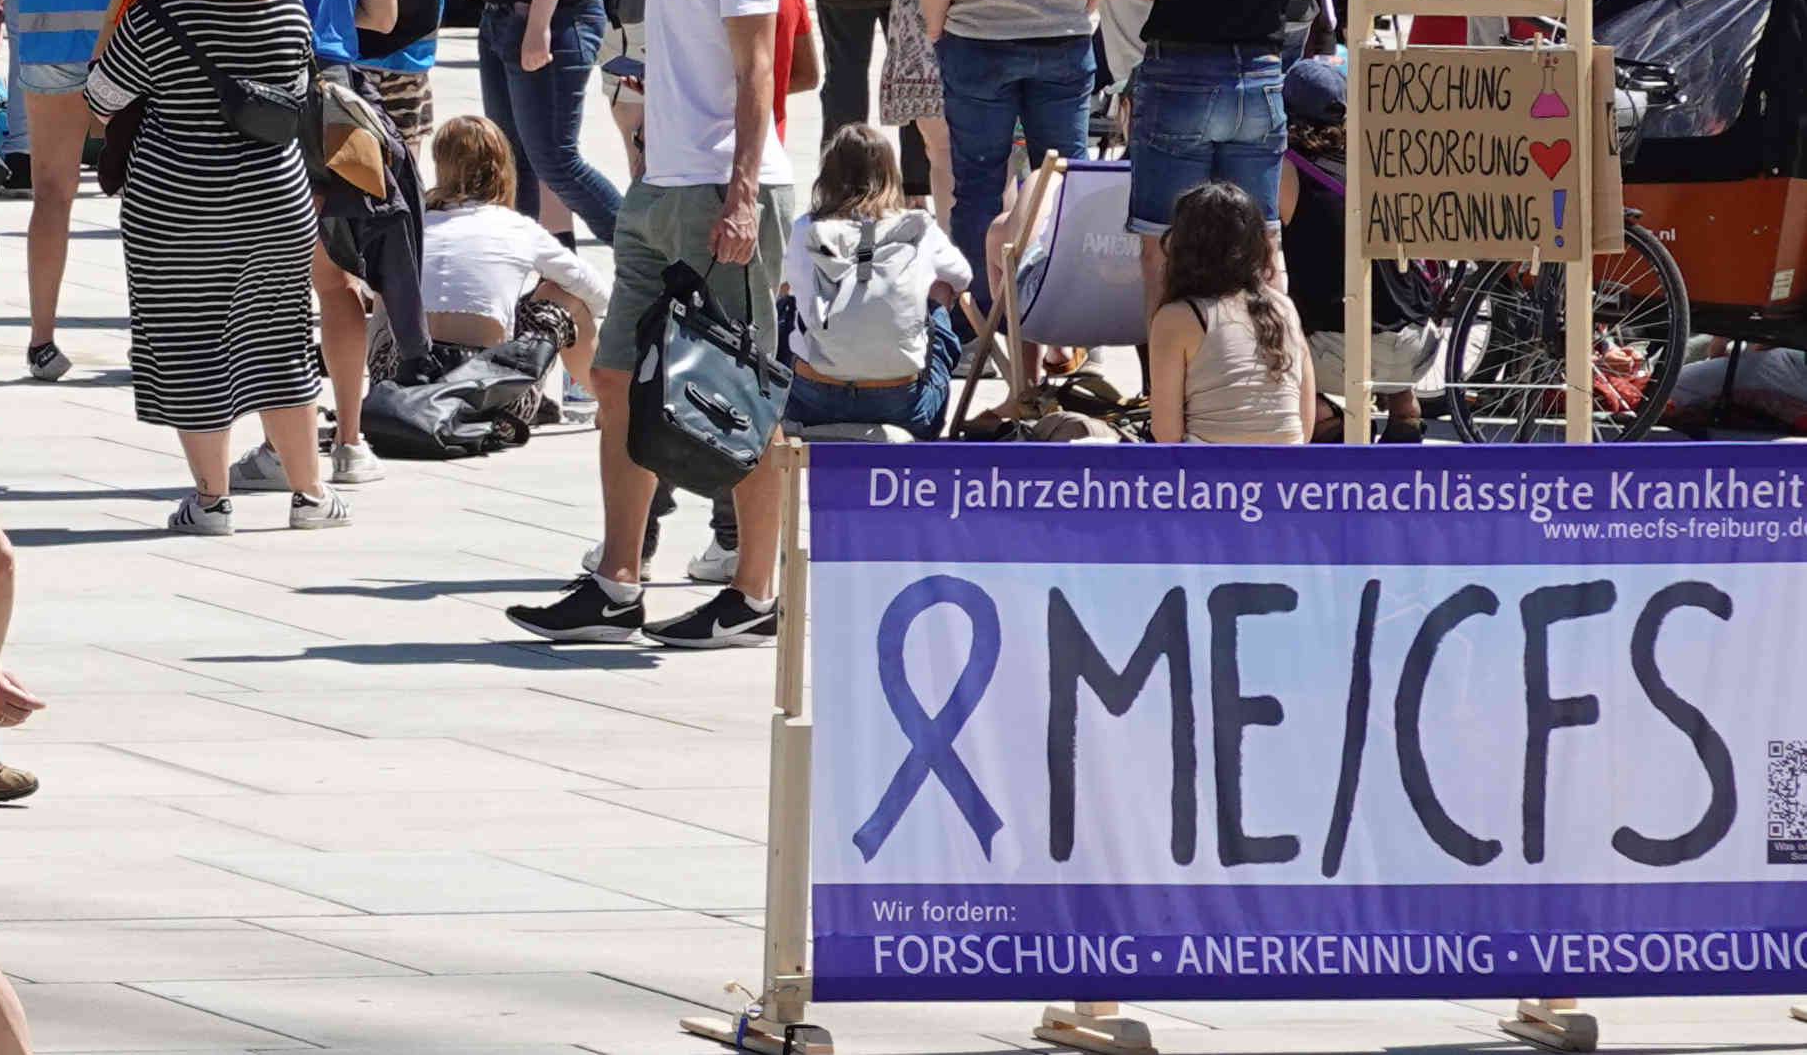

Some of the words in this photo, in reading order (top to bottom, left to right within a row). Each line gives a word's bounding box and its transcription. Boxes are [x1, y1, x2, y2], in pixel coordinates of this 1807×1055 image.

[1367, 62, 1512, 115] FORSCHUNG
[1365, 128, 1530, 178] VERSORGUNG
[1367, 190, 1541, 244] ANERKENNUNG
[869, 467, 937, 507] Die
[949, 466, 1264, 523] jahrzehntelang
[1277, 469, 1594, 523] vernachlässigte
[1046, 576, 1740, 878] ME/CFS
[872, 900, 914, 922] Wir
[921, 900, 1019, 922] fordern:
[873, 934, 1139, 975] FORSCHUNG
[1175, 935, 1495, 975] ANERKENNUNG
